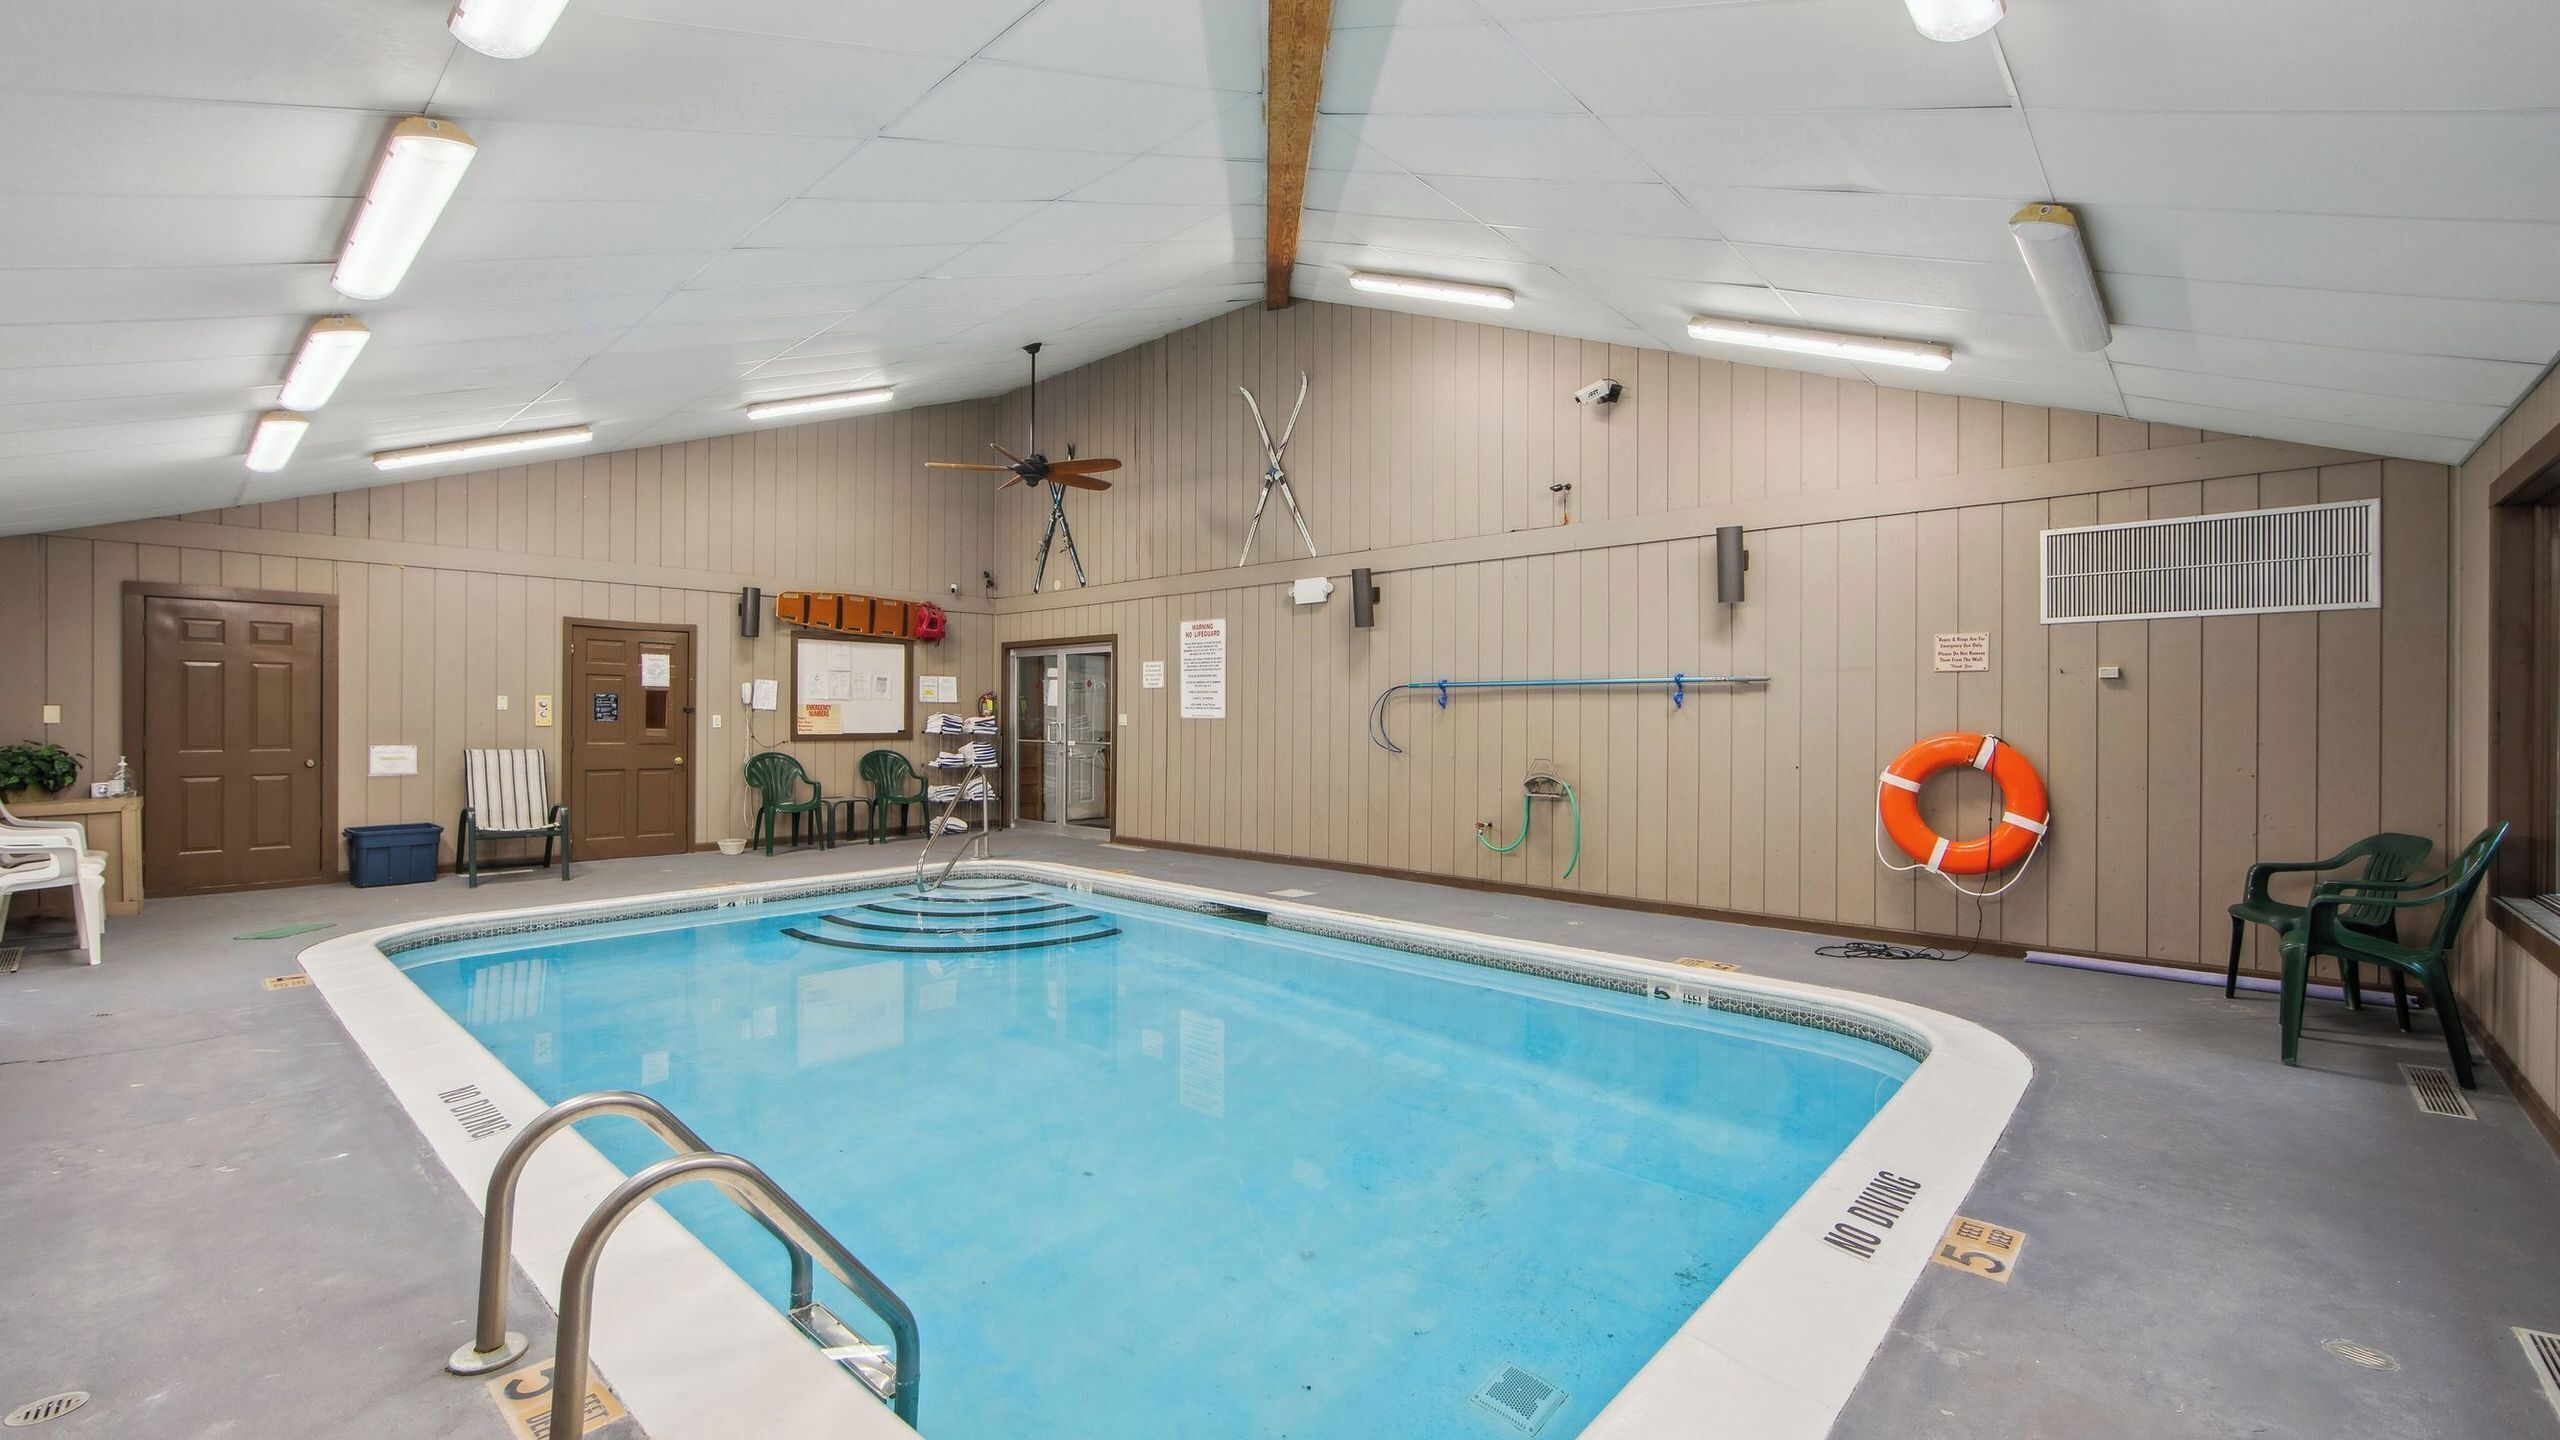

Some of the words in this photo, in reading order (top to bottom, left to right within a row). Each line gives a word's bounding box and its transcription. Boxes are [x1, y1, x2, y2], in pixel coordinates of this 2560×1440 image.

[1194, 630, 1220, 638] LIFEGUARD
[1654, 985, 1671, 1000] 5
[437, 1084, 482, 1103] NO
[449, 1098, 512, 1139] DIVING
[1846, 1169, 1922, 1229] DIVING
[1823, 1222, 1881, 1259] NO
[1956, 1221, 1985, 1241] FEET
[1986, 1229, 2015, 1250] DEEP
[1940, 1243, 2006, 1274] 5
